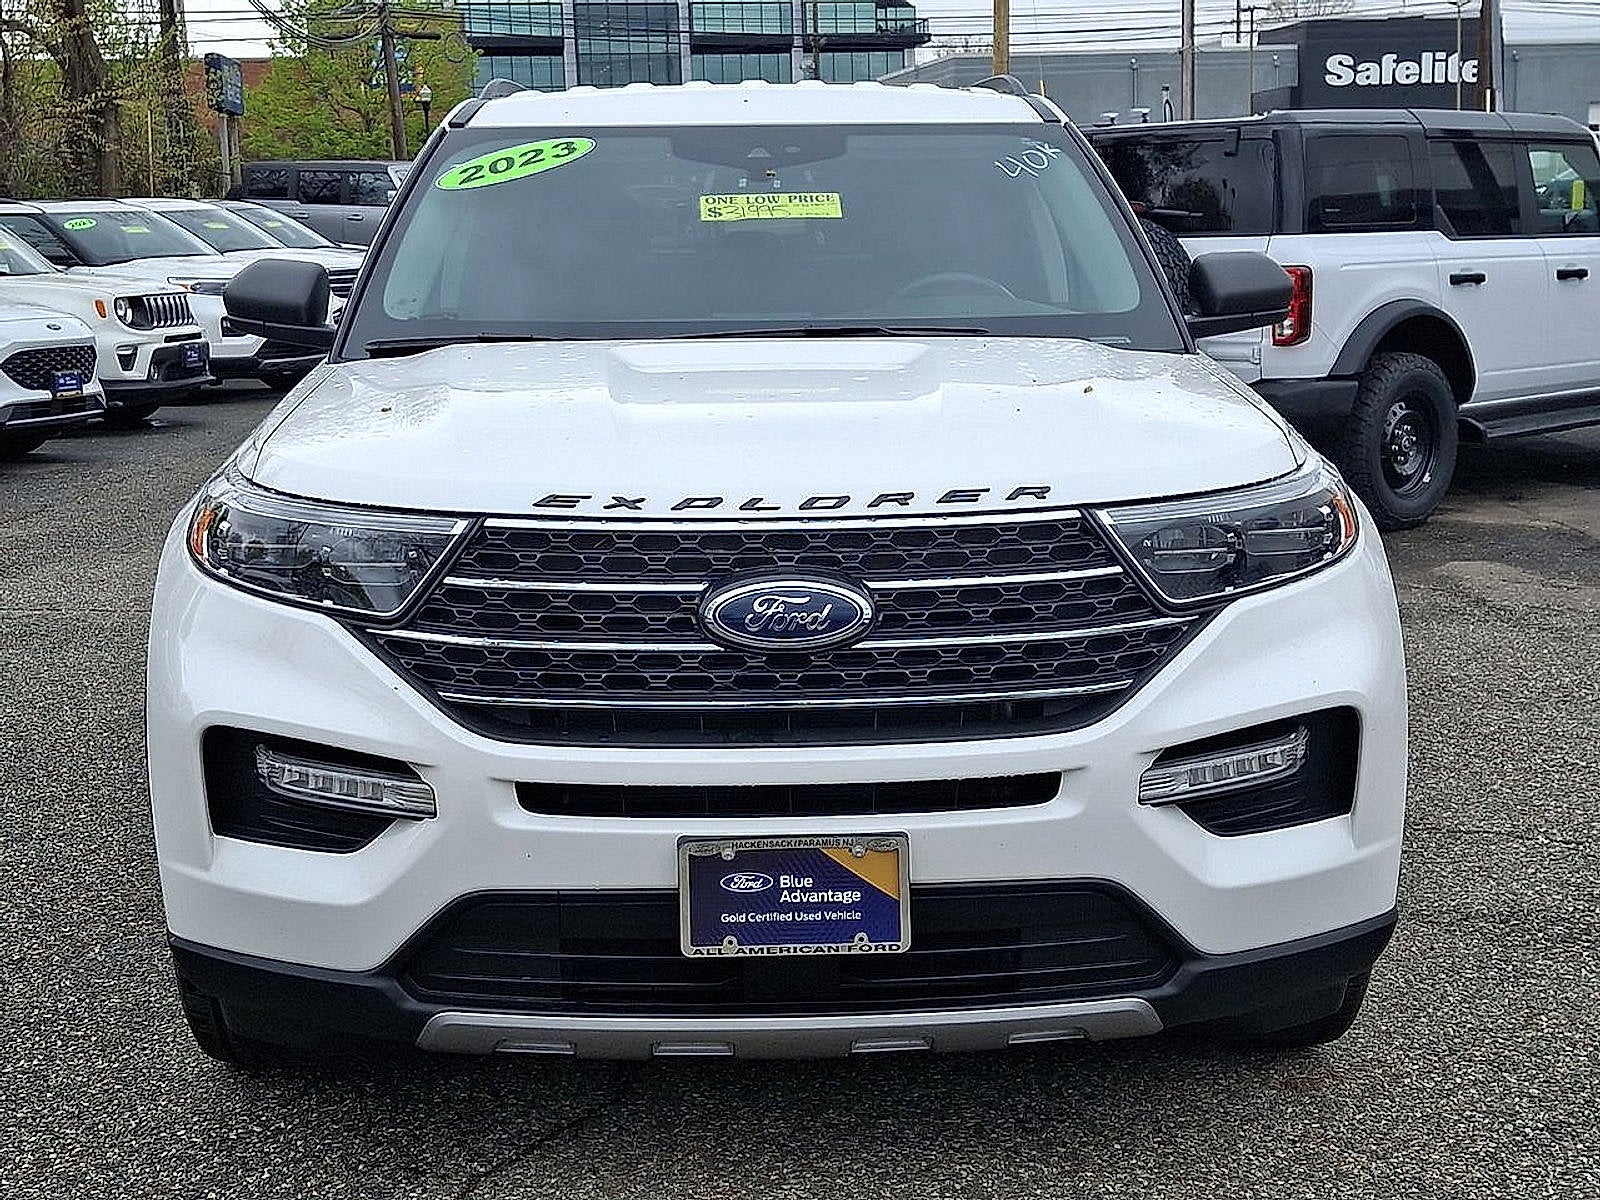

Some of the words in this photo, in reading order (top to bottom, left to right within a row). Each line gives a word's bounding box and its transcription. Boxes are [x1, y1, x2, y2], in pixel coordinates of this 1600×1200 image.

[1325, 52, 1479, 86] Safelite
[458, 141, 578, 186] 2023
[705, 196, 738, 205] ONE
[746, 195, 780, 205] LOW
[788, 194, 836, 203] PRICE
[532, 485, 1052, 512] EXPLORER
[744, 595, 833, 632] Ford
[842, 837, 855, 848] NJ
[779, 875, 813, 889] Blue
[779, 889, 862, 905] Advantage
[720, 912, 746, 923] Gold
[747, 911, 792, 923] Certified
[794, 910, 822, 922] Used
[824, 909, 862, 921] Vehicle
[692, 946, 730, 956] ALL
[735, 945, 840, 955] AMERICAN
[848, 943, 902, 953] FORD
